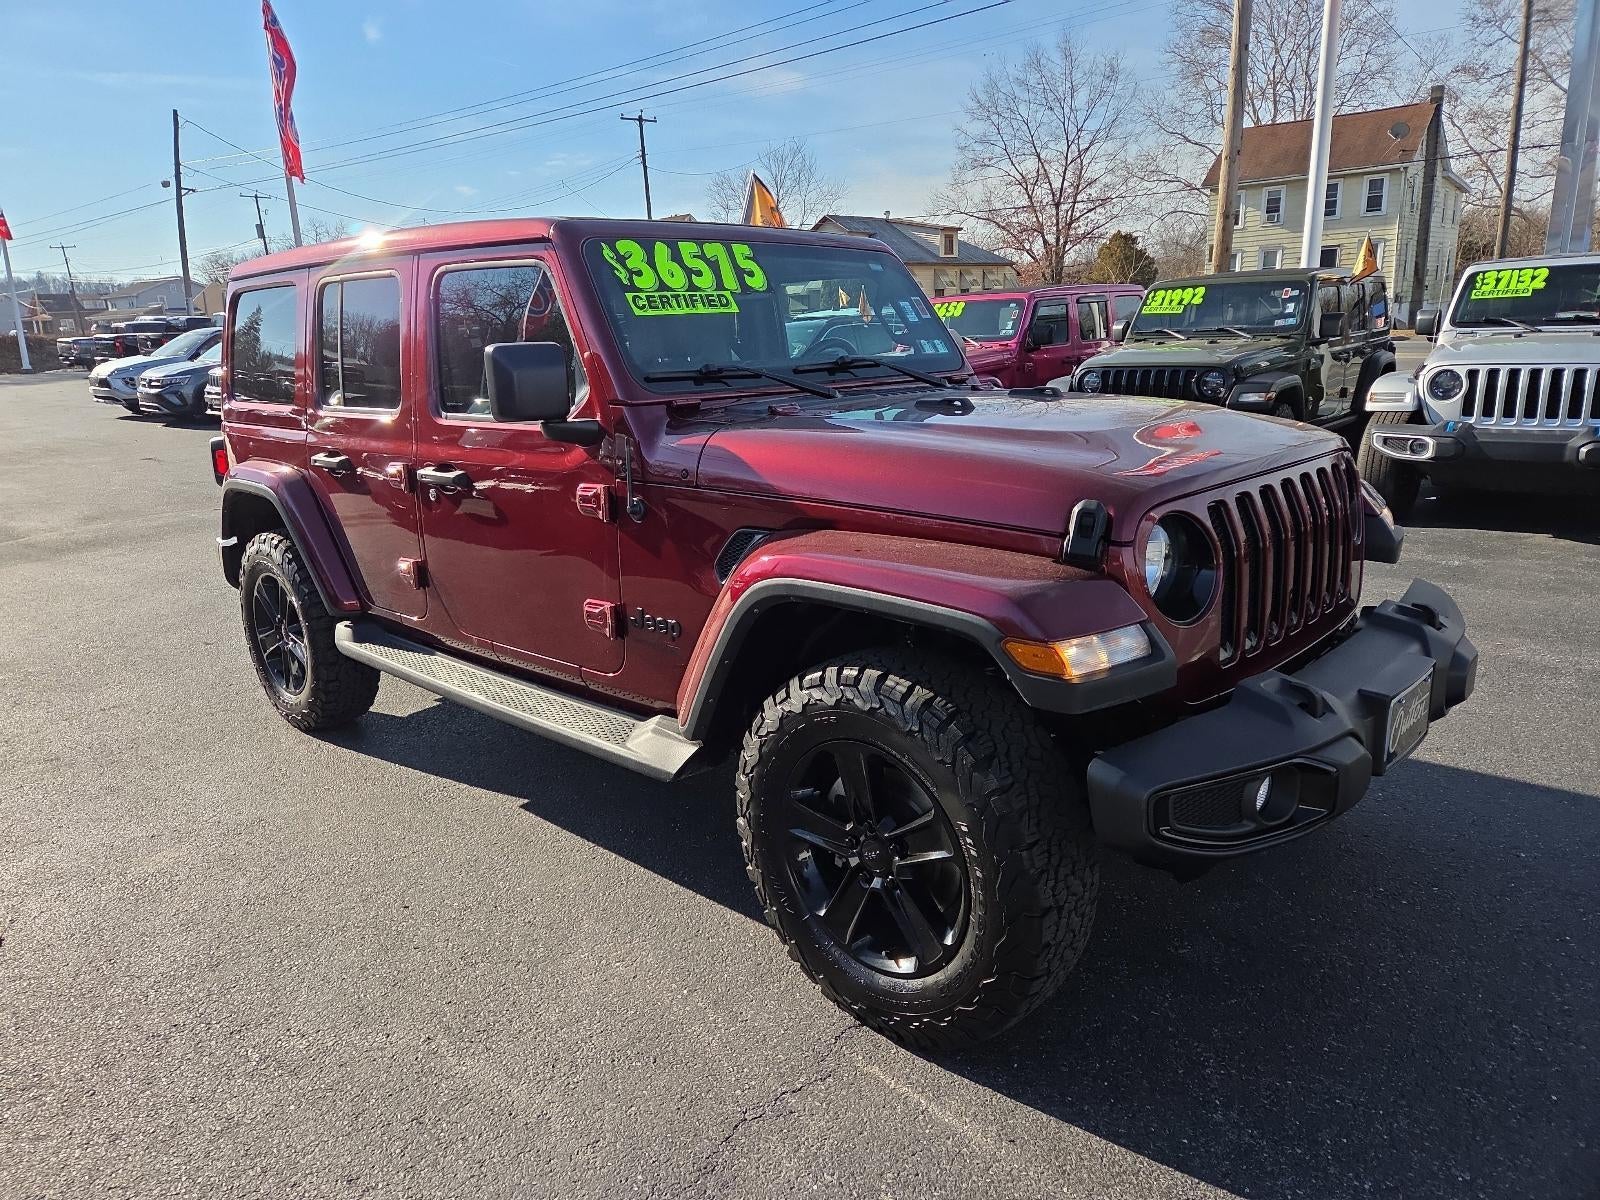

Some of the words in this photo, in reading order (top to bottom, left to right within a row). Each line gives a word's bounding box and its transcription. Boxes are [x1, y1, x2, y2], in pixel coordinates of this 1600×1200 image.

[600, 239, 769, 293] $36575
[1475, 267, 1550, 291] $37132
[631, 293, 731, 312] CERTIFIED
[1473, 287, 1530, 297] CERTIFIED
[629, 607, 682, 641] Jeep
